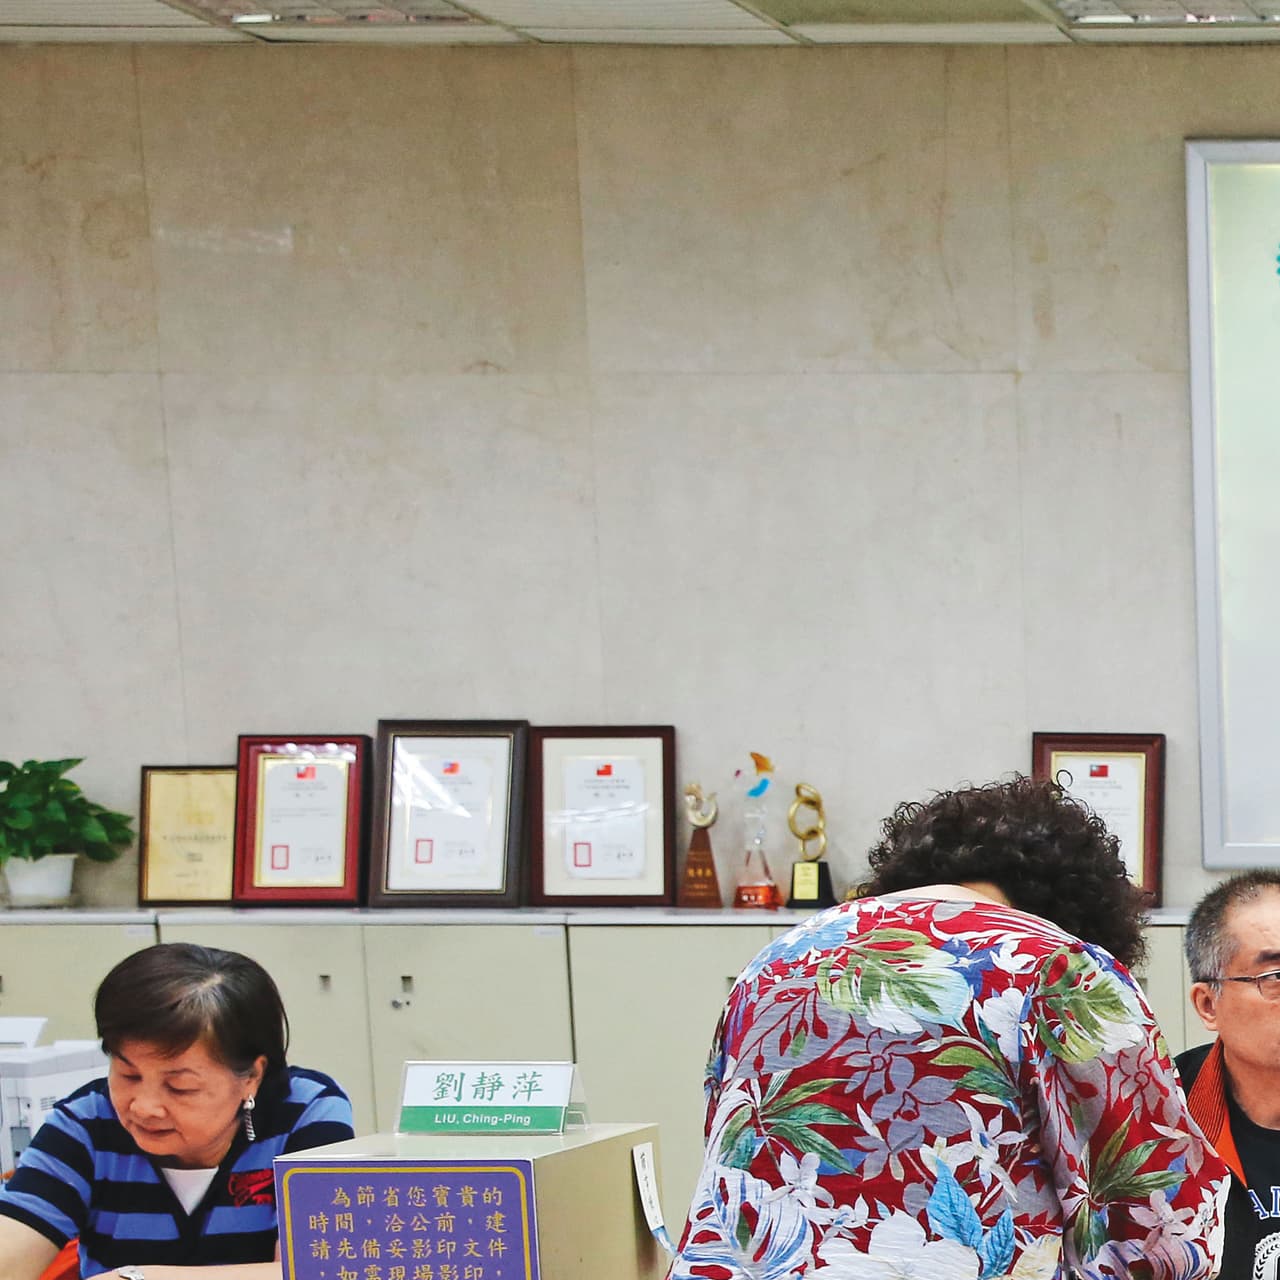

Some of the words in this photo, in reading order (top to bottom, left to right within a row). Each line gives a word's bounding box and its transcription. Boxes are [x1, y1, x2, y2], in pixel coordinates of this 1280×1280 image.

[432, 1071, 543, 1102] 劉靜萍
[434, 1114, 459, 1125] LIU,
[463, 1113, 531, 1127] Ching-Ping
[331, 1186, 503, 1208] 為節省您寶貴的
[309, 1238, 508, 1260] 請先備妥影印文件
